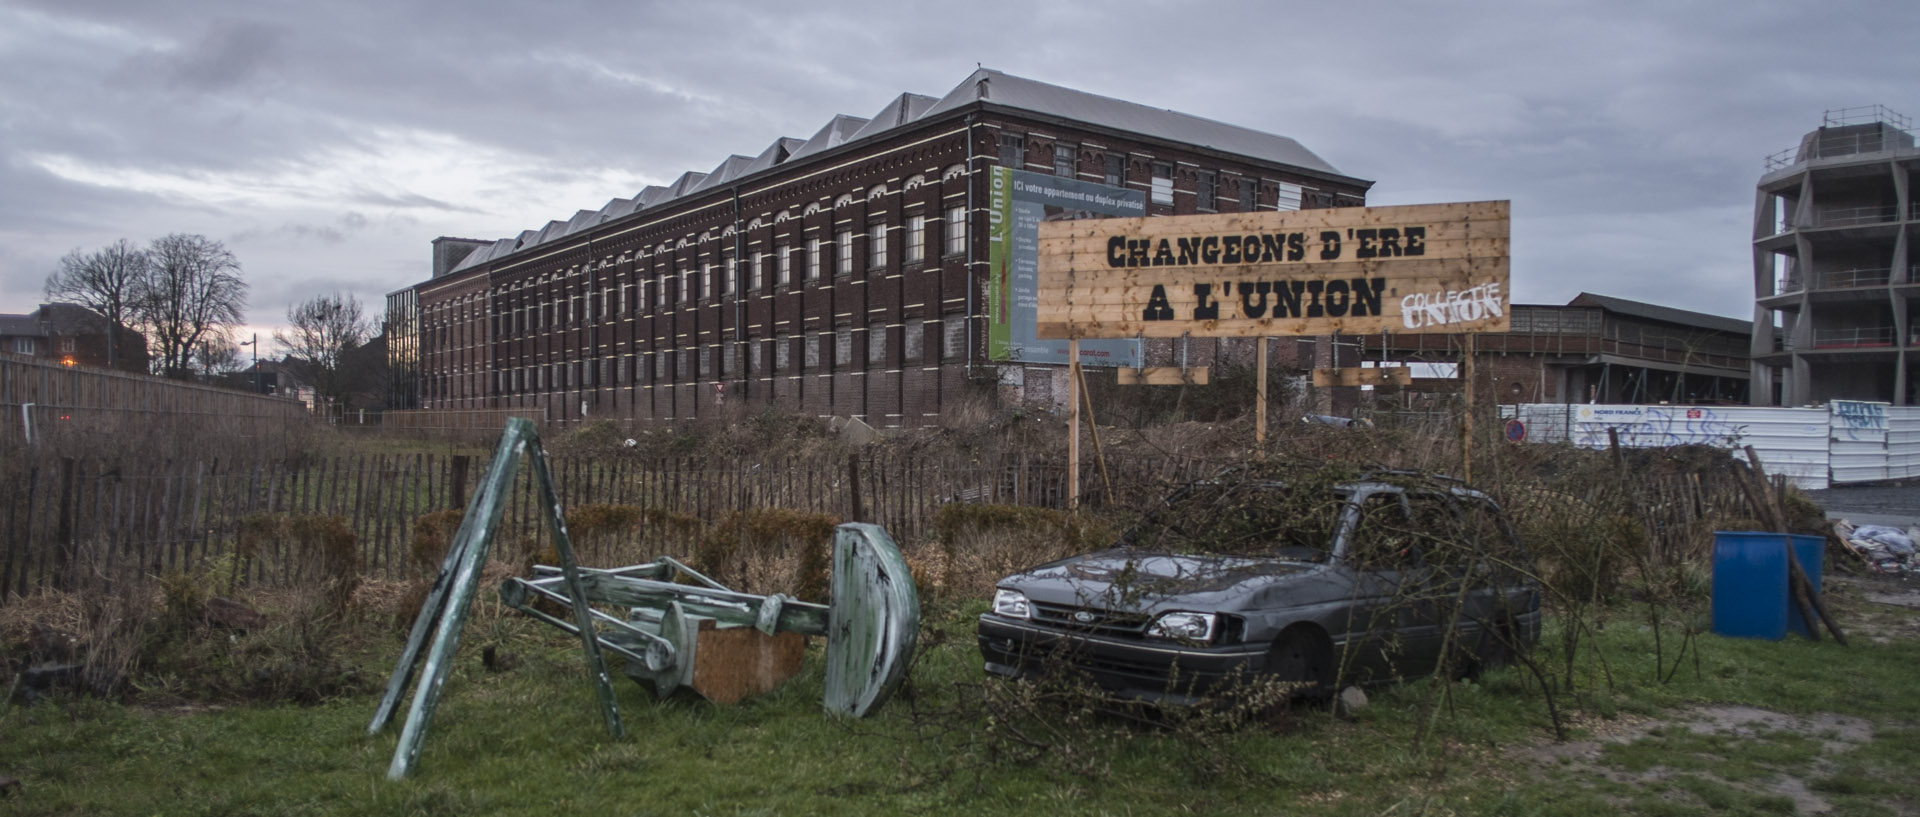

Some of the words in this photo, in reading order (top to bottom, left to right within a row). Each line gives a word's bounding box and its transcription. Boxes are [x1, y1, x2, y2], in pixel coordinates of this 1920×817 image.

[990, 165, 1003, 242] L'Union
[1014, 180, 1024, 190] ICI
[1024, 183, 1043, 194] votre
[1043, 187, 1085, 200] appartement
[1085, 193, 1094, 202] ou
[1094, 193, 1116, 206] duplex
[1107, 232, 1305, 268] CHANGEONS
[1320, 226, 1426, 260] D'ERE
[1143, 284, 1175, 321] A
[1194, 277, 1386, 321] L'UNION
[1401, 297, 1503, 329] UNION
